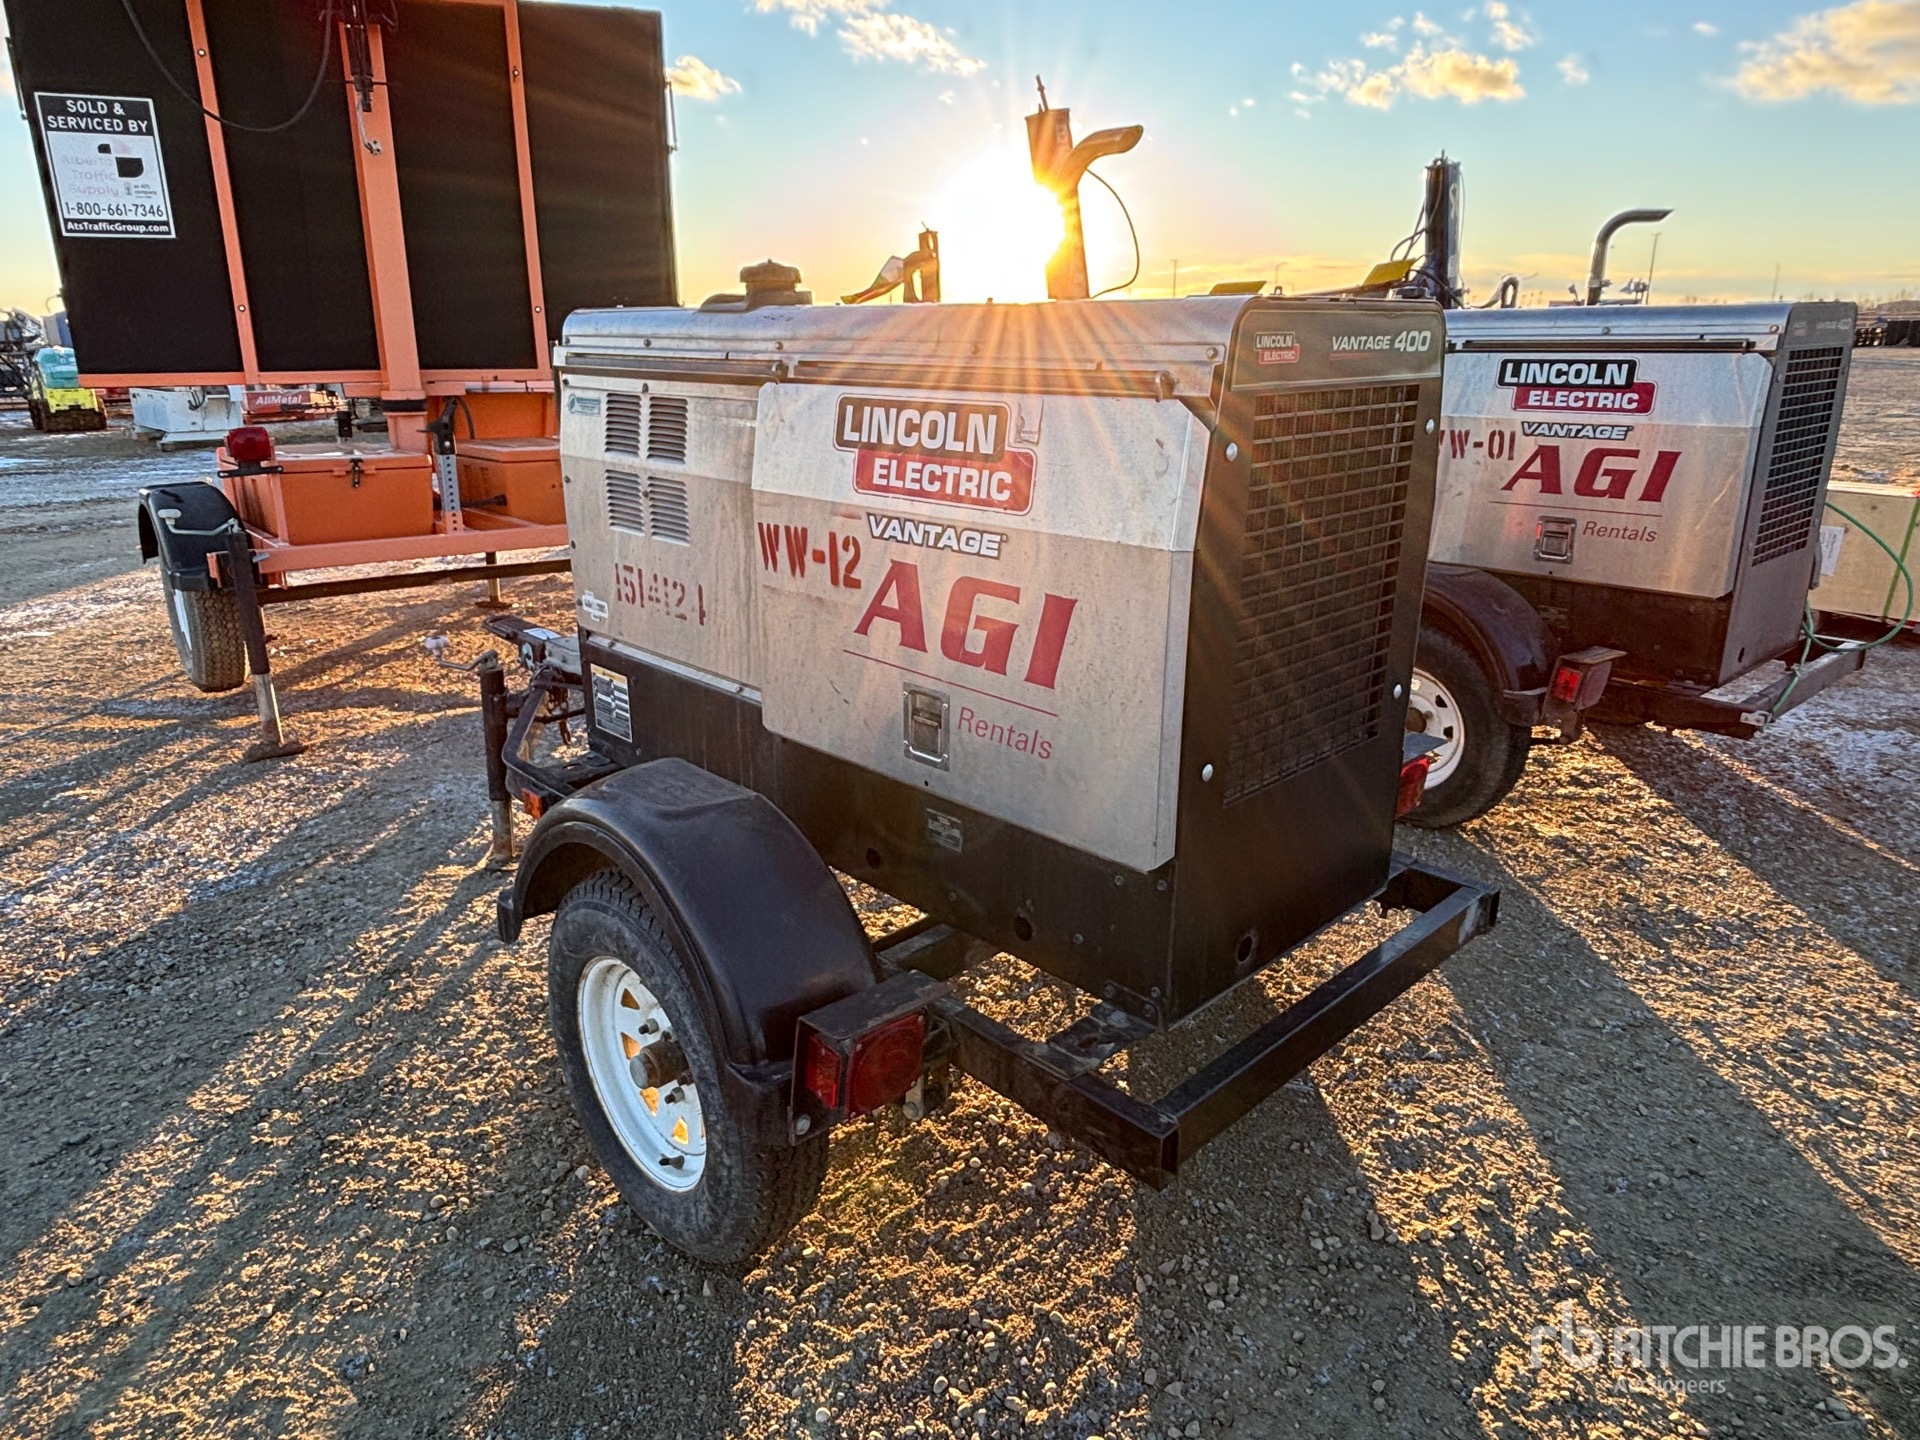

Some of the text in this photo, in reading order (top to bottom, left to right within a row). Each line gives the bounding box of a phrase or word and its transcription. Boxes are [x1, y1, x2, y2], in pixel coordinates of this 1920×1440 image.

[66, 100, 126, 116] SOLD &
[47, 116, 148, 133] SERVICED BY
[64, 202, 164, 217] 1-800-661-7346
[66, 221, 170, 233] AtsTrafficGroup.com
[1256, 334, 1293, 348] LINCOLN
[1332, 330, 1432, 352] VANTAGE 400
[1263, 350, 1296, 361] ELECTRIC
[1504, 362, 1628, 386] LINCOLN
[255, 394, 302, 405] AllMetal
[1527, 391, 1639, 409] ELECTRIC
[843, 404, 999, 455] LINCOLN
[1522, 422, 1629, 440] VANTAGE
[872, 458, 1012, 501] ELECTRIC
[1500, 444, 1682, 503] AGI
[867, 513, 1001, 558] VANTAGE
[1582, 520, 1658, 543] Rentals
[757, 521, 862, 589] WW-12
[853, 558, 1079, 690] AGI
[957, 706, 1053, 760] Rentals
